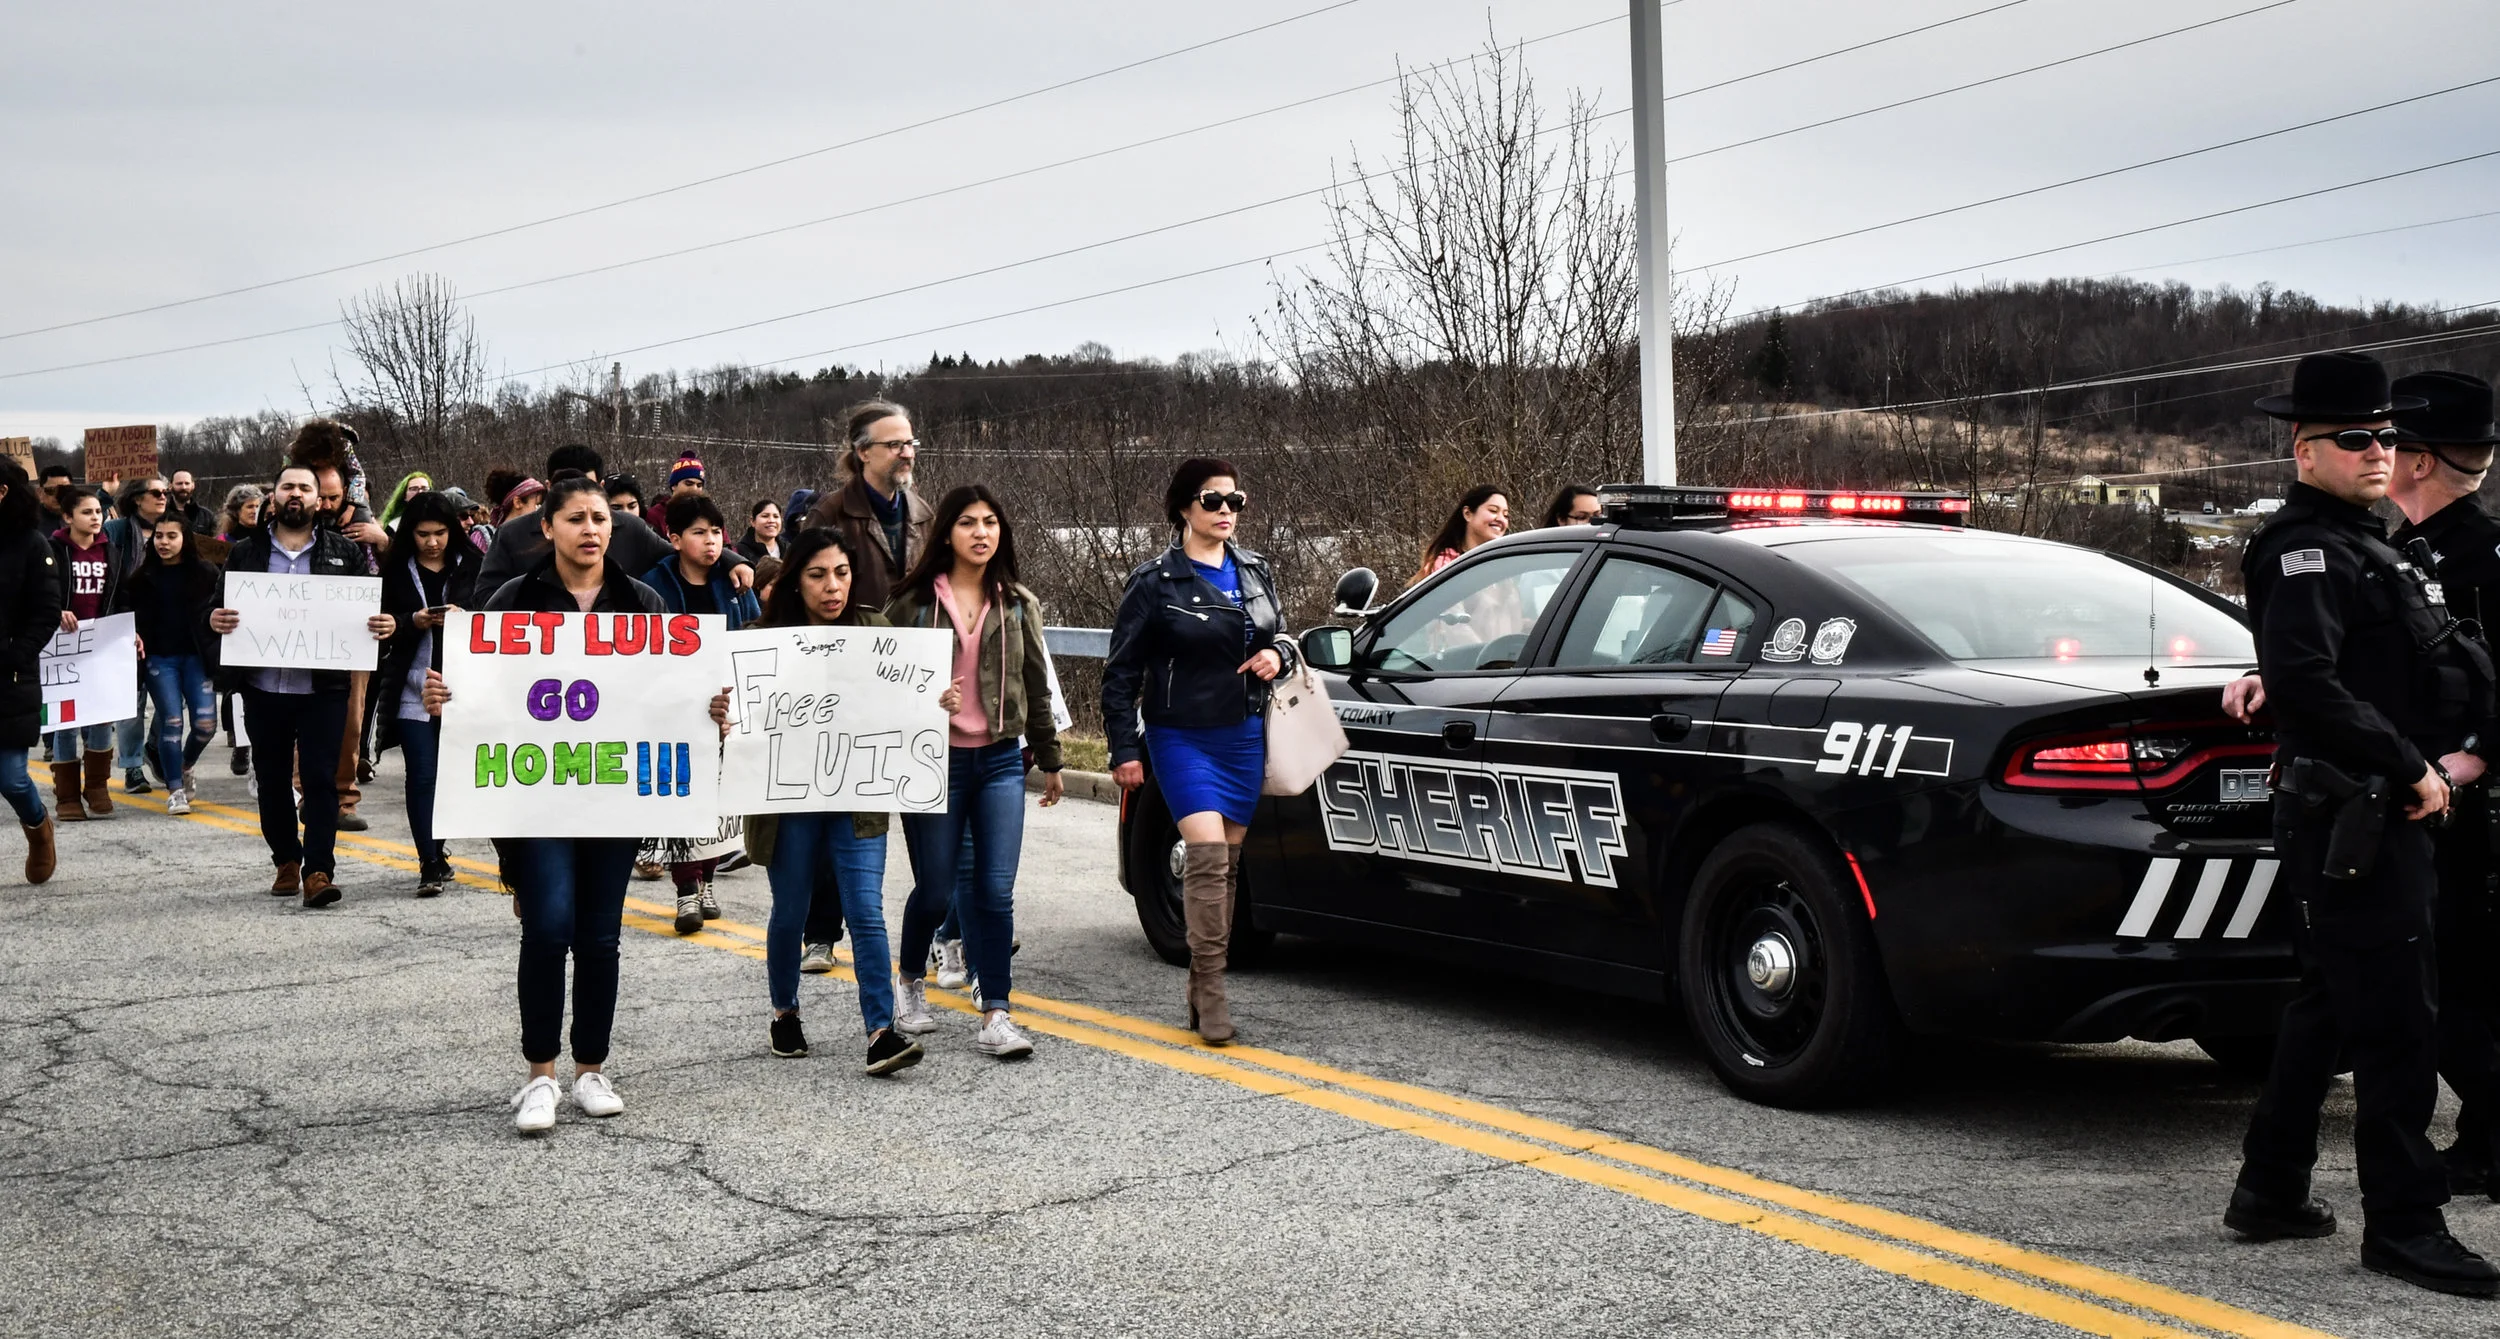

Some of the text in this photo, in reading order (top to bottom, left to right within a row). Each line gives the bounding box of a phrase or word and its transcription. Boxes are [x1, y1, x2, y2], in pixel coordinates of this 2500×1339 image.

[119, 427, 154, 442] ABOUT
[121, 442, 151, 454] THOSE
[87, 456, 128, 469] WITHOUT
[234, 579, 313, 601] MAKE
[278, 607, 312, 622] NOT
[470, 611, 701, 656] LET LUIS
[872, 636, 898, 657] NO
[527, 678, 600, 722] GO
[732, 647, 841, 735] Free
[1340, 706, 1396, 726] COUNTY
[1815, 721, 1914, 778] 911
[475, 741, 692, 797] HOME!!!
[766, 728, 946, 812] LUIS
[1317, 752, 1627, 887] SHERIFF
